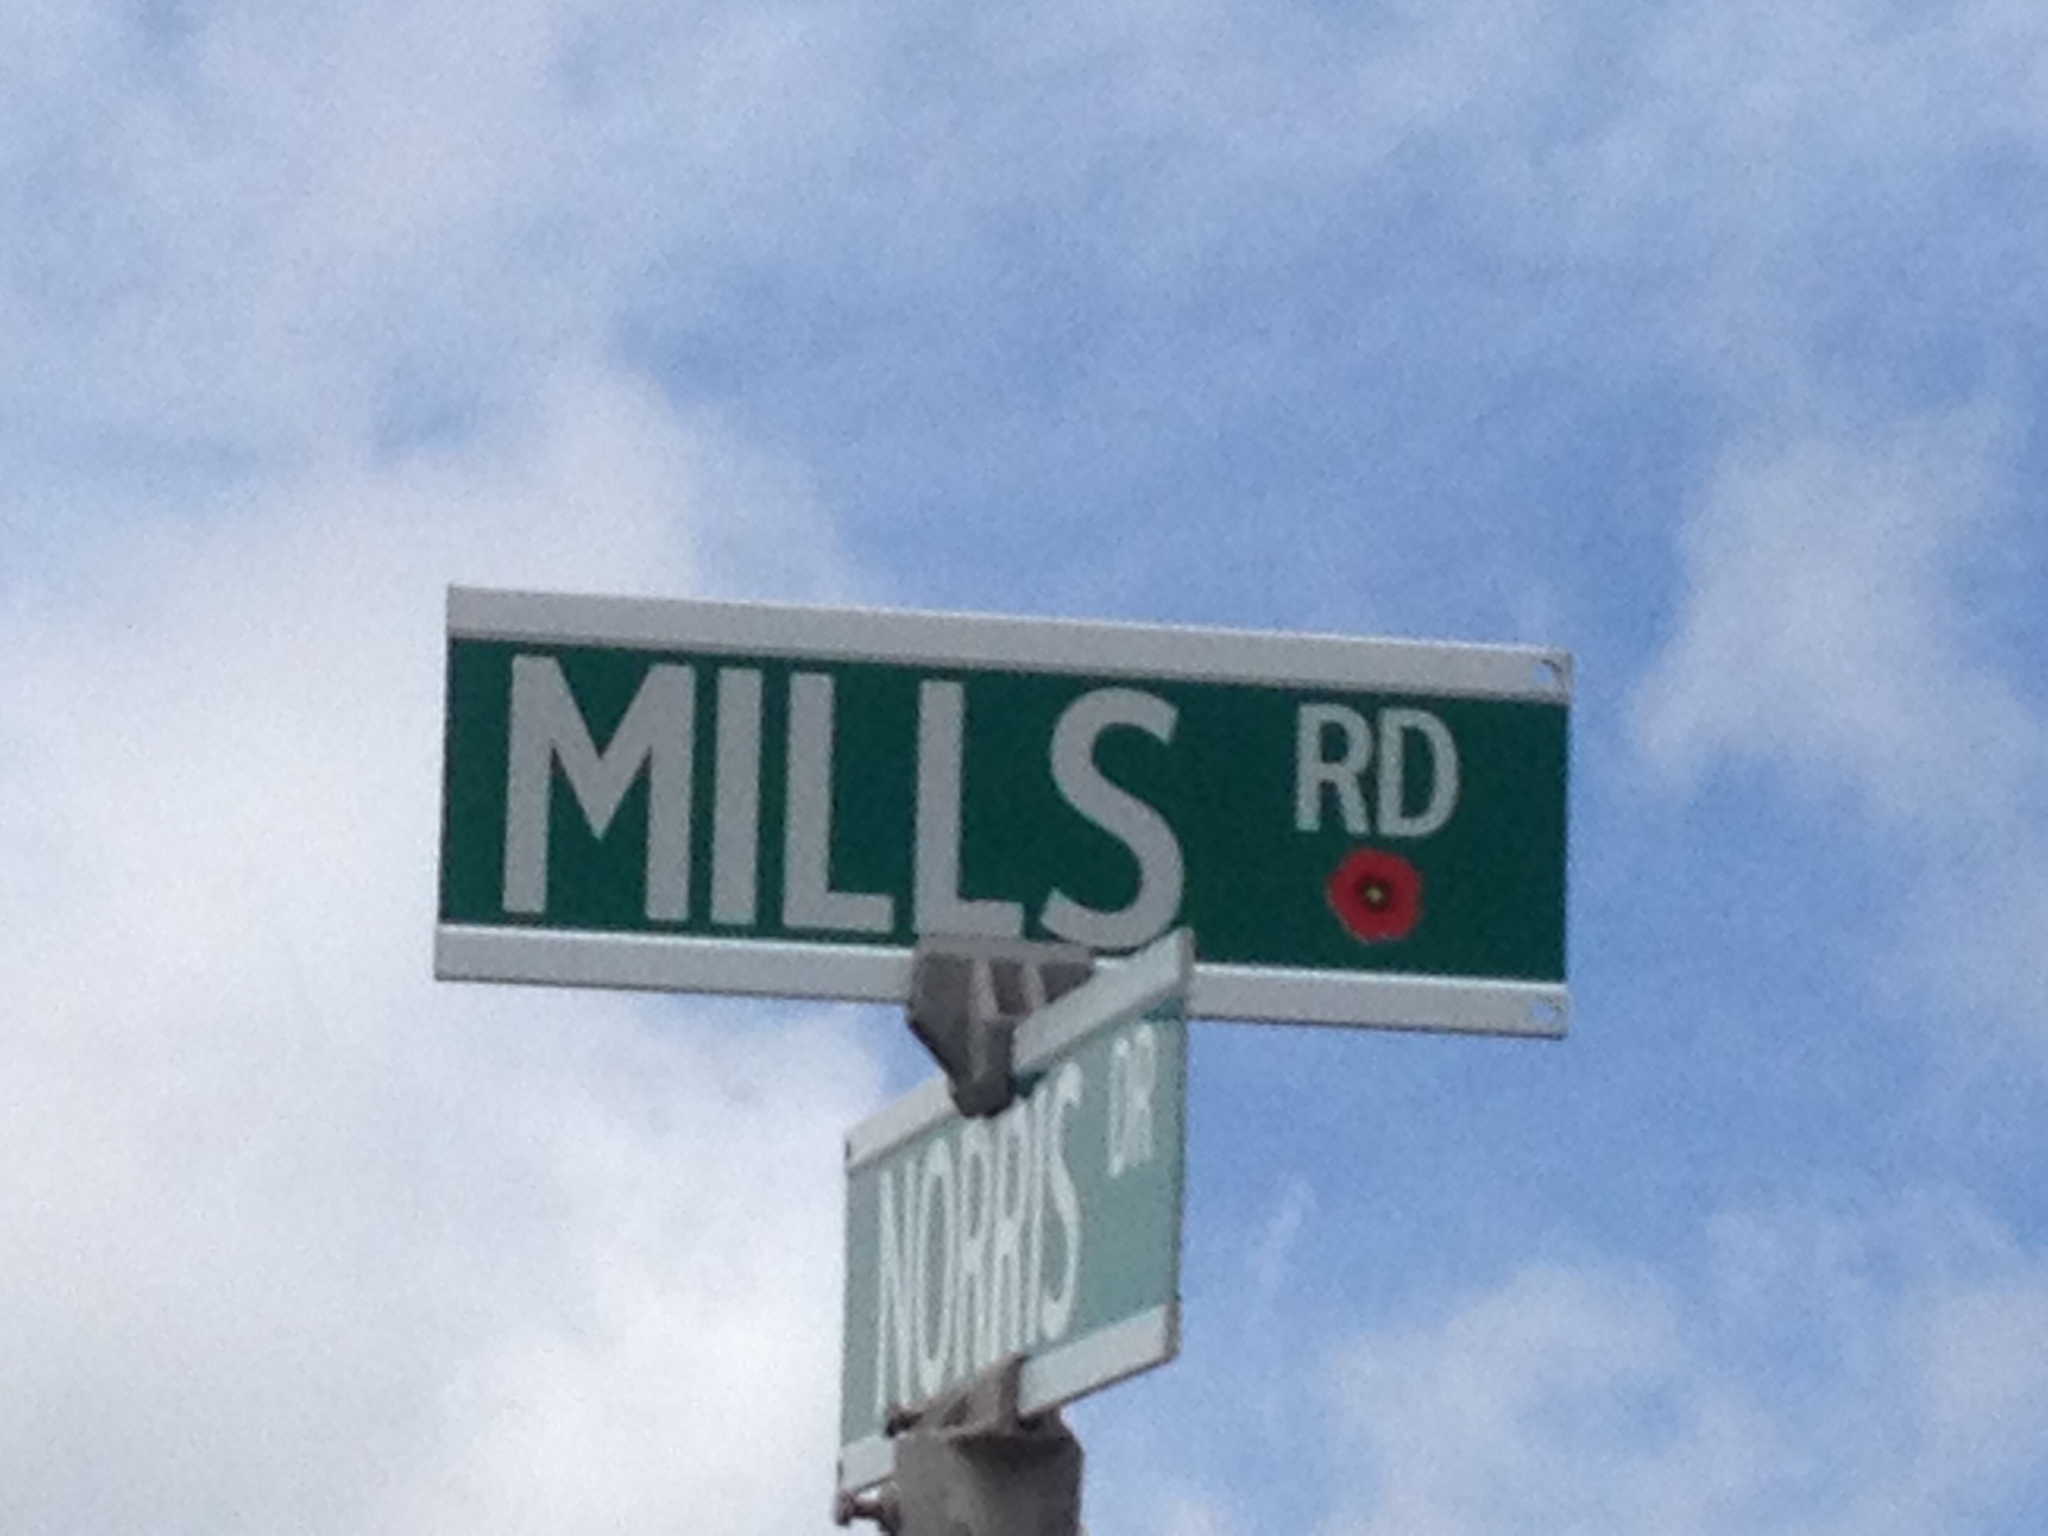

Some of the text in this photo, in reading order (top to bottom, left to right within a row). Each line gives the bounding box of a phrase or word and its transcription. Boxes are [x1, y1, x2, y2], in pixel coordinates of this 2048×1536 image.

[503, 654, 1459, 949] MILLS RD
[874, 1022, 1157, 1422] NORRIS DR
